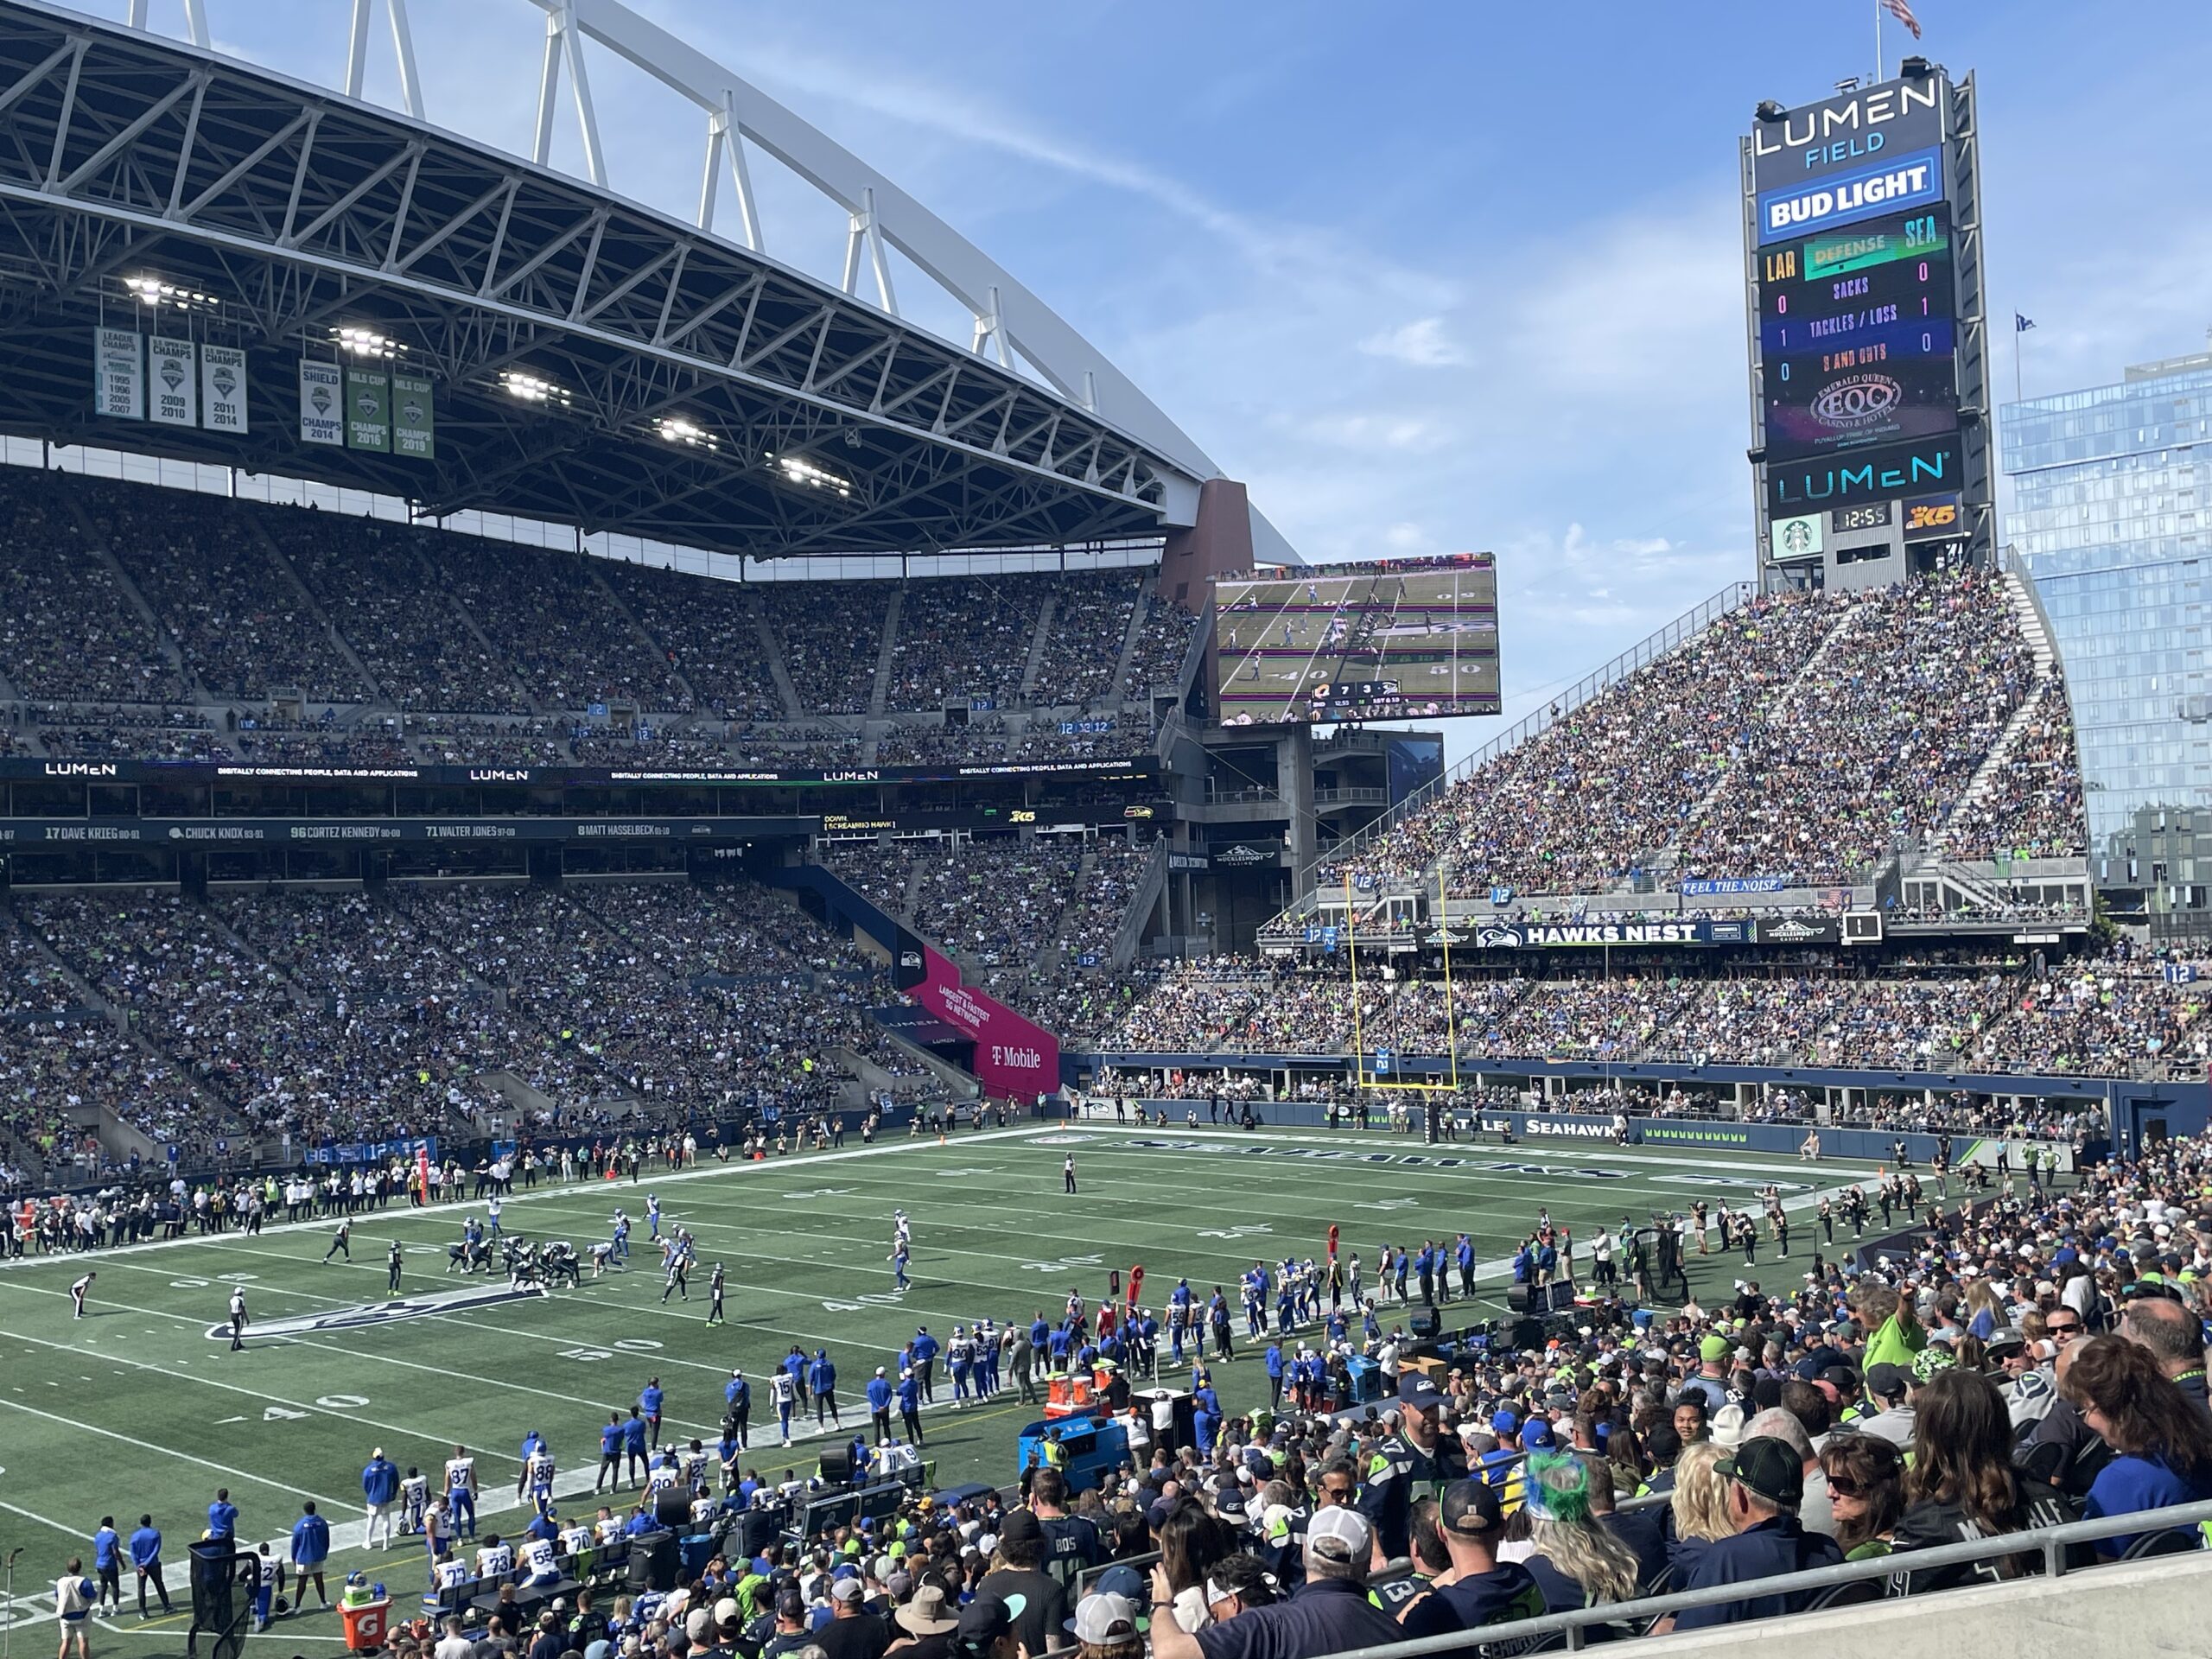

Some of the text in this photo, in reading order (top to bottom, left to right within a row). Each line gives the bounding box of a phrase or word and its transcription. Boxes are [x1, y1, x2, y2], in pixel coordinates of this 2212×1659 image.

[1756, 78, 1936, 156] LUMEN
[1805, 132, 1885, 168] FIELD
[1771, 166, 1927, 228] BUD LIGHT
[1905, 215, 1936, 249] SEA
[1815, 235, 1885, 264] DEFENSE
[1766, 251, 1796, 282] LAR
[1919, 263, 1928, 282] 0
[1833, 276, 1869, 300] SACKS
[1778, 296, 1787, 314] 0
[1922, 296, 1928, 315] 1
[1810, 314, 1854, 338] TACKLES
[1870, 304, 1897, 324] LOSS
[104, 332, 134, 344] LEAGUE
[1781, 329, 1786, 346] 1
[1923, 333, 1930, 352] 0
[102, 340, 136, 352] CHAMPS
[153, 346, 191, 359] CHAMPS
[206, 354, 242, 367] CHAMPS
[1834, 343, 1886, 370] AND OUTS
[303, 371, 338, 385] SHIELD
[349, 372, 386, 386] MLS CUP
[1781, 363, 1789, 381] 0
[110, 374, 130, 385] 1995
[394, 379, 430, 393] MLS CUP
[1818, 373, 1892, 398] EMERALD QUEEN
[110, 385, 130, 395] 1996
[110, 394, 130, 404] 2005
[161, 394, 185, 407] 2009
[1818, 384, 1893, 419] EQC
[110, 404, 130, 414] 2007
[162, 406, 185, 418] 2010
[213, 403, 235, 414] 2011
[214, 414, 237, 425] 2014
[1819, 416, 1853, 429] CASINO
[1863, 404, 1896, 424] HOTEL
[302, 417, 341, 431] CHAMPS
[351, 422, 386, 435] CHAMPS
[311, 429, 334, 439] 2014
[357, 433, 381, 446] 2016
[397, 428, 431, 442] CHAMPS
[1815, 434, 1845, 444] PUYALLUP
[402, 439, 426, 452] 2019
[1779, 452, 1943, 504] LUMEN
[1341, 684, 1371, 695] 7 3
[977, 702, 988, 710] 12
[1061, 723, 1073, 734] 12
[1095, 722, 1108, 732] 12
[639, 730, 650, 740] 12
[45, 763, 116, 775] LUMEN
[470, 770, 528, 780] LUMEN
[1032, 764, 1056, 772] PEOPLE,
[823, 770, 879, 782] LUMEN
[45, 827, 118, 840] 17 DAVE KRIEG
[185, 827, 216, 839] CHUCK
[218, 827, 243, 839] KNOX
[290, 826, 379, 838] 96 CORTEZ KENNEDY
[425, 825, 497, 837] 71 WALTER JONES
[577, 824, 654, 836] 8 MATT HASSELBECK
[1358, 875, 1371, 887] 12
[1683, 880, 1778, 895] FEEL THE NOISE
[1496, 889, 1510, 903] 12
[1308, 929, 1320, 943] 12
[1528, 926, 1619, 943] HAWKS
[1625, 925, 1697, 942] NEST
[1083, 956, 1095, 966] 12
[2171, 966, 2190, 982] 12
[938, 984, 963, 1005] LARGEST
[967, 1001, 990, 1022] FASTEST
[954, 1004, 981, 1028] NETWORK
[1004, 1047, 1041, 1068] Mobile
[1526, 1119, 1616, 1138] SEAHAWK
[821, 1294, 904, 1312] 40
[1173, 1312, 1185, 1324] 59
[556, 1339, 664, 1362] 50
[952, 1348, 967, 1359] 90
[779, 1382, 791, 1395] 15
[1726, 1388, 1745, 1403] 83
[263, 1394, 370, 1421] 40
[906, 1447, 917, 1460] 9
[887, 1453, 897, 1469] 11
[451, 1468, 469, 1484] 87
[536, 1465, 554, 1481] 88
[415, 1487, 423, 1502] 3
[1957, 1498, 2063, 1542] MALF
[571, 1535, 590, 1551] 70
[533, 1548, 553, 1565] 55
[490, 1555, 509, 1573] 73
[446, 1568, 467, 1586] 77
[357, 1613, 378, 1637] G
